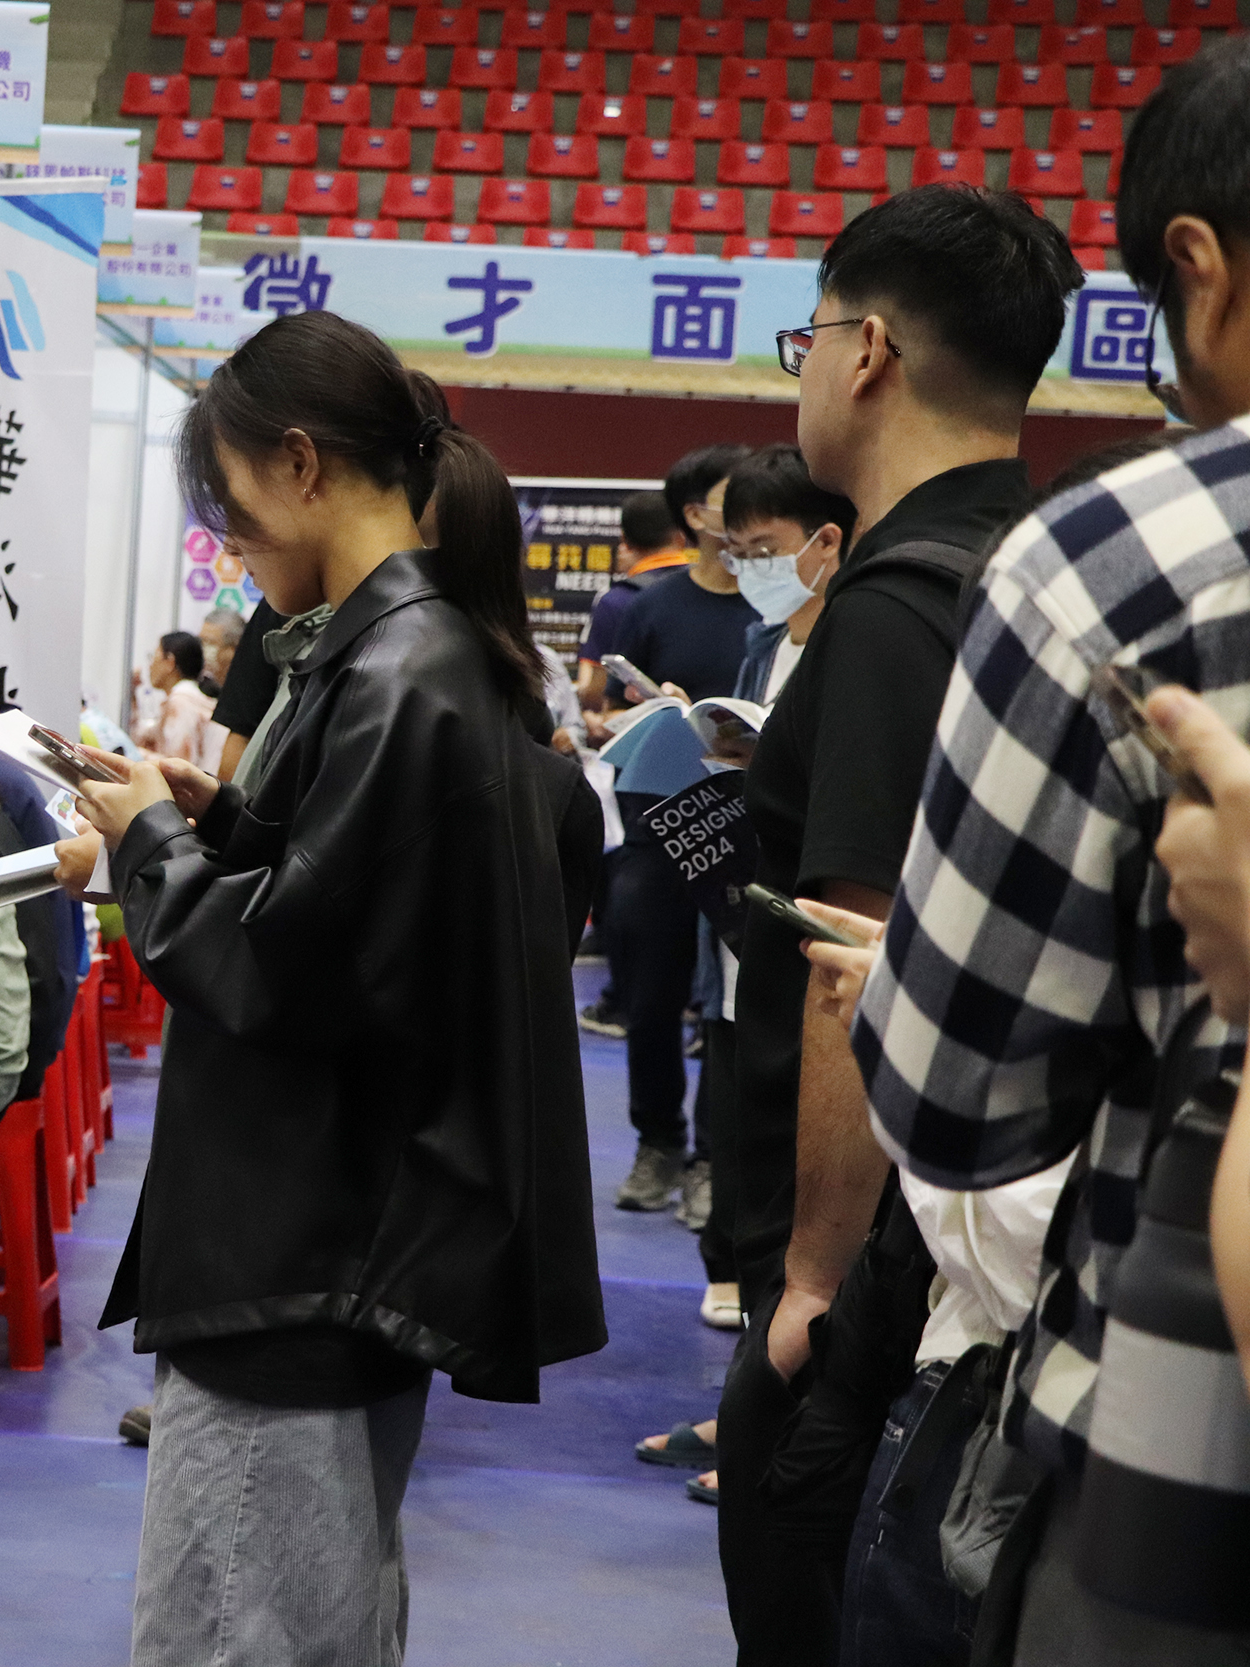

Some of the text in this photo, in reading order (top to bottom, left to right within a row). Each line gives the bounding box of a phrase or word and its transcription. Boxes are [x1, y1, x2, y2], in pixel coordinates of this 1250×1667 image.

[107, 259, 191, 276] 股份有限公司
[650, 785, 725, 836] SOCIAL
[679, 836, 735, 881] 2024
